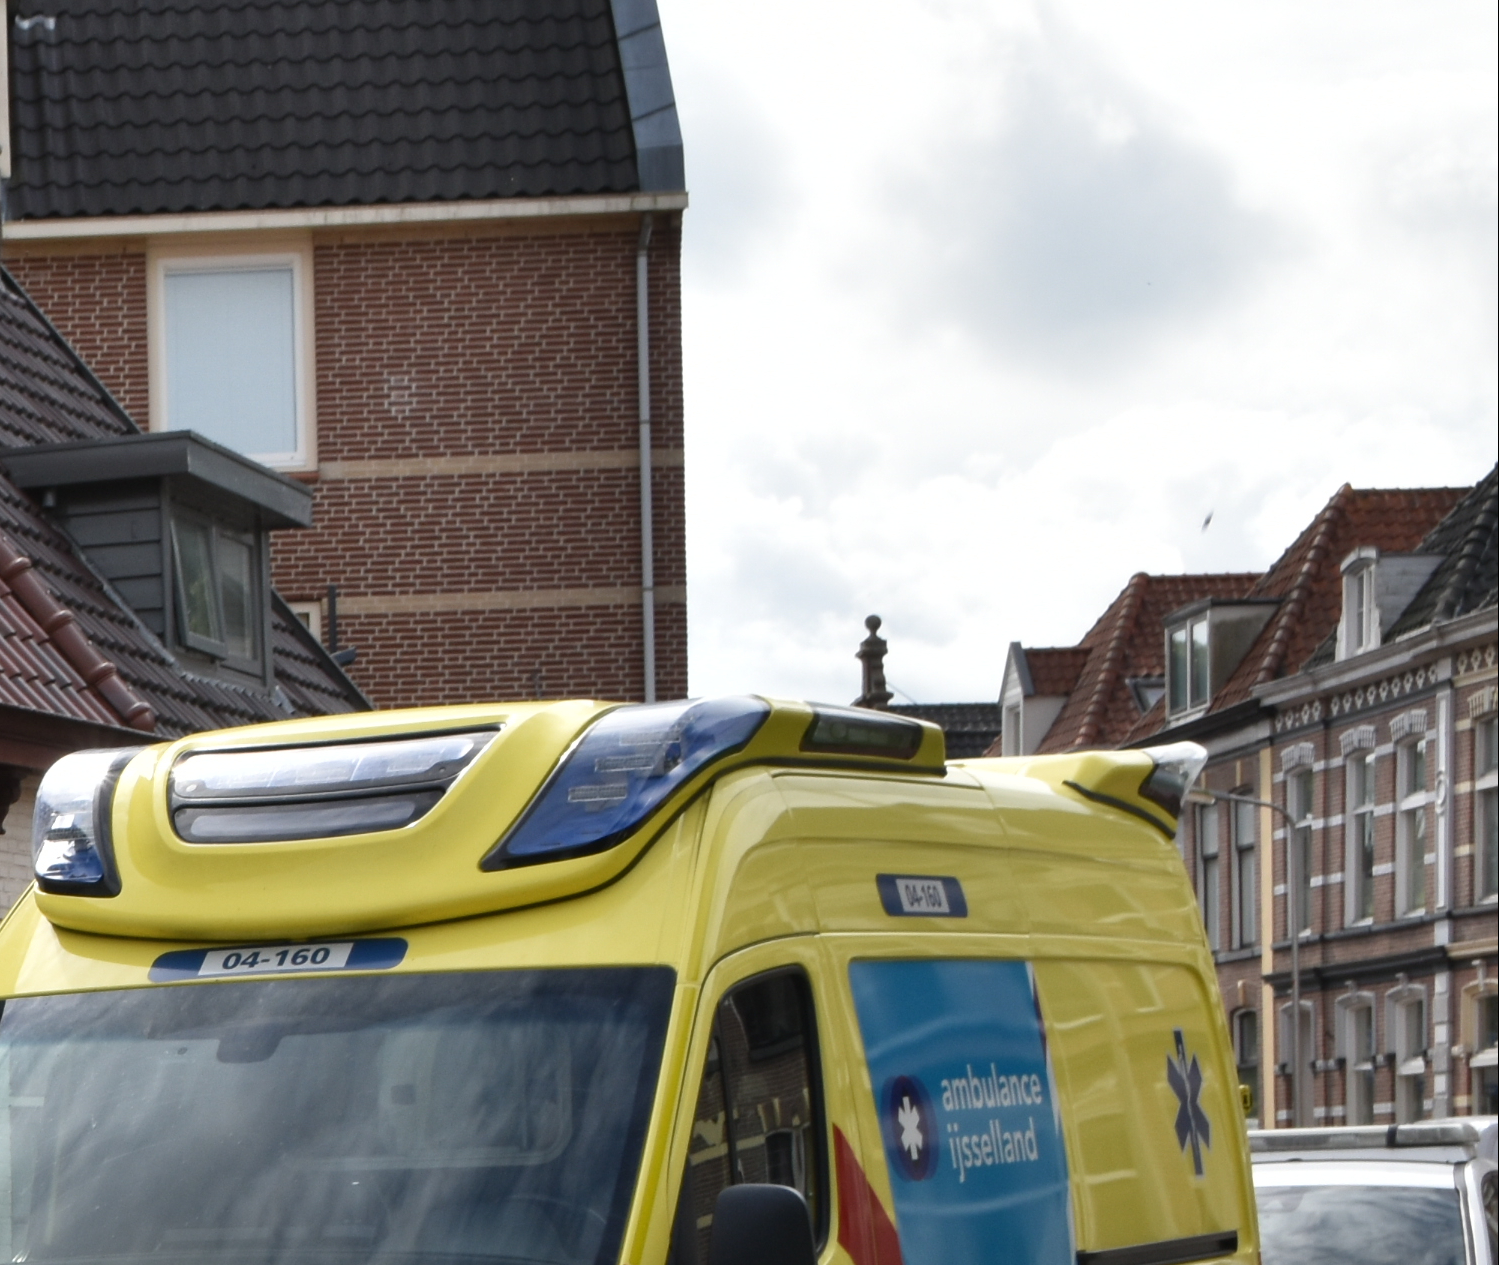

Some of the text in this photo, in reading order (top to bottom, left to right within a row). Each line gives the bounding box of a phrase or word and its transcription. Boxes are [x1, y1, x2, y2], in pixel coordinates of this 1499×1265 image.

[905, 884, 942, 908] 04-160
[221, 947, 331, 970] 04-160
[941, 1062, 1043, 1112] ambulance
[947, 1115, 1039, 1184] ijsselland
